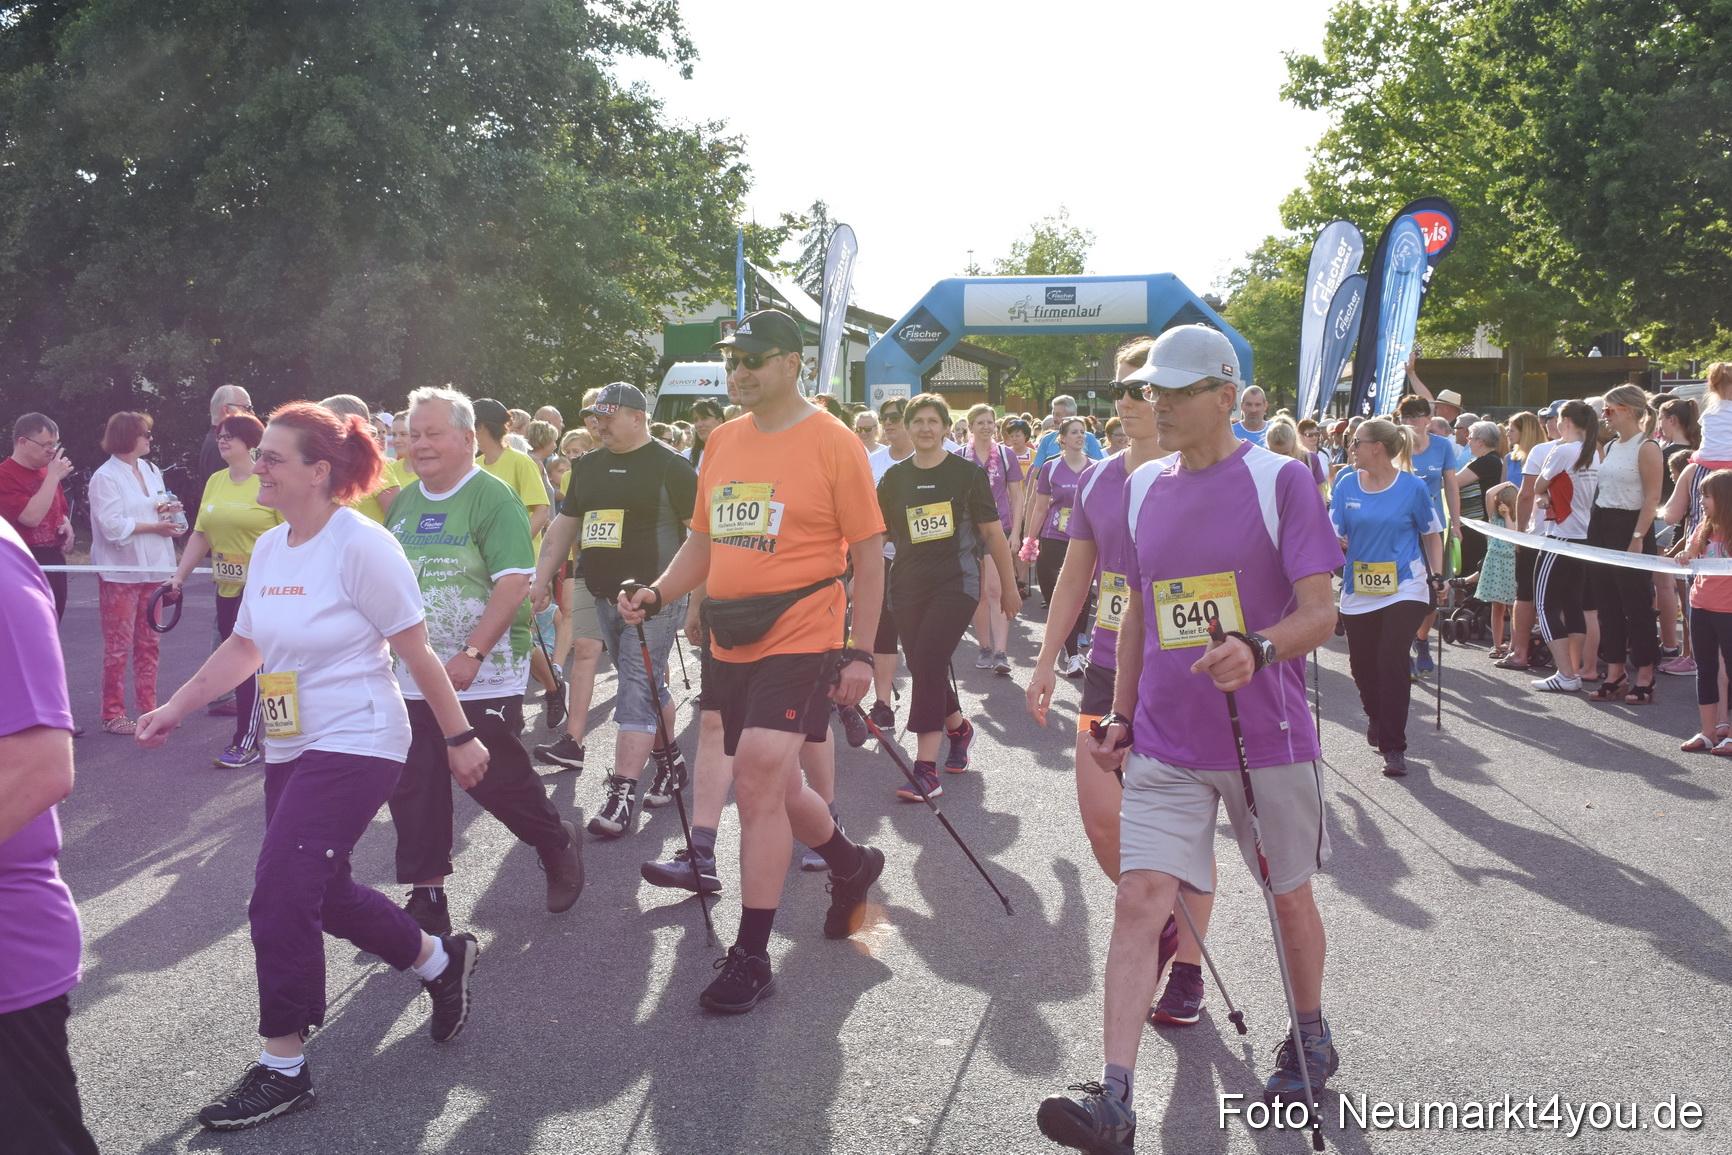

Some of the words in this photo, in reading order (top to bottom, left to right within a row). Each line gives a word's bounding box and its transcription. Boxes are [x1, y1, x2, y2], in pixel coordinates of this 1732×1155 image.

[1320, 237, 1348, 303] Fischer
[1034, 304, 1102, 318] firmenlauf
[1339, 290, 1359, 332] Fischer
[906, 330, 941, 338] Fischer
[716, 501, 760, 523] 1160
[585, 523, 616, 538] 1957
[913, 514, 948, 533] 1954
[400, 529, 470, 546] firmenlauf
[418, 556, 459, 565] Firmen
[215, 562, 243, 576] 1303
[422, 566, 467, 582] länger!
[1358, 573, 1391, 586] 1084
[267, 586, 307, 596] KLEBL
[1172, 600, 1219, 629] 640
